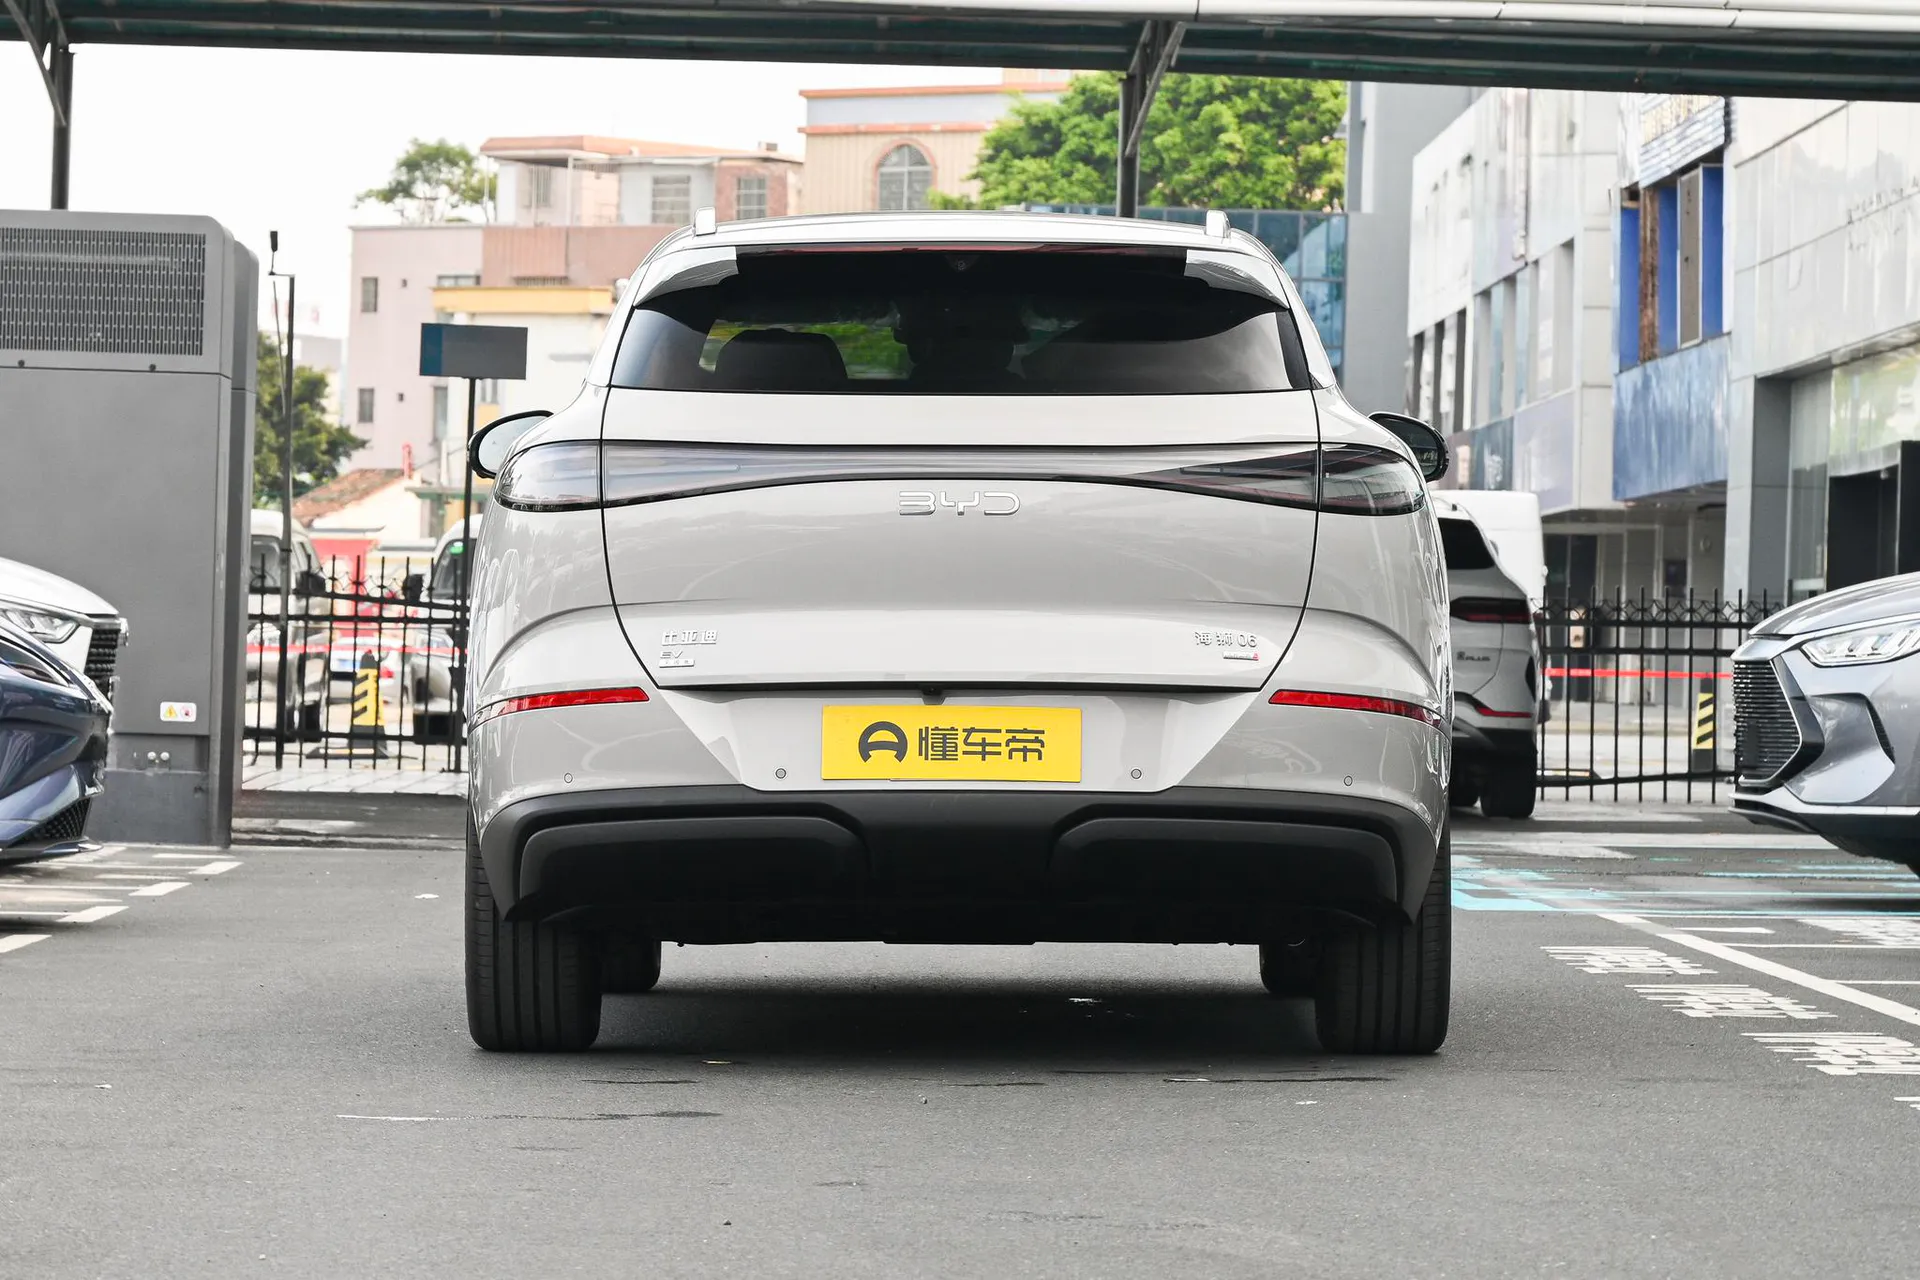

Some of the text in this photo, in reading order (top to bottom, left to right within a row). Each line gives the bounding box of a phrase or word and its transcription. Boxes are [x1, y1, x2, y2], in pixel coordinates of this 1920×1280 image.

[898, 490, 1021, 516] BYD
[661, 629, 718, 646] 比亚迪
[918, 726, 1046, 762] 懂车帝
